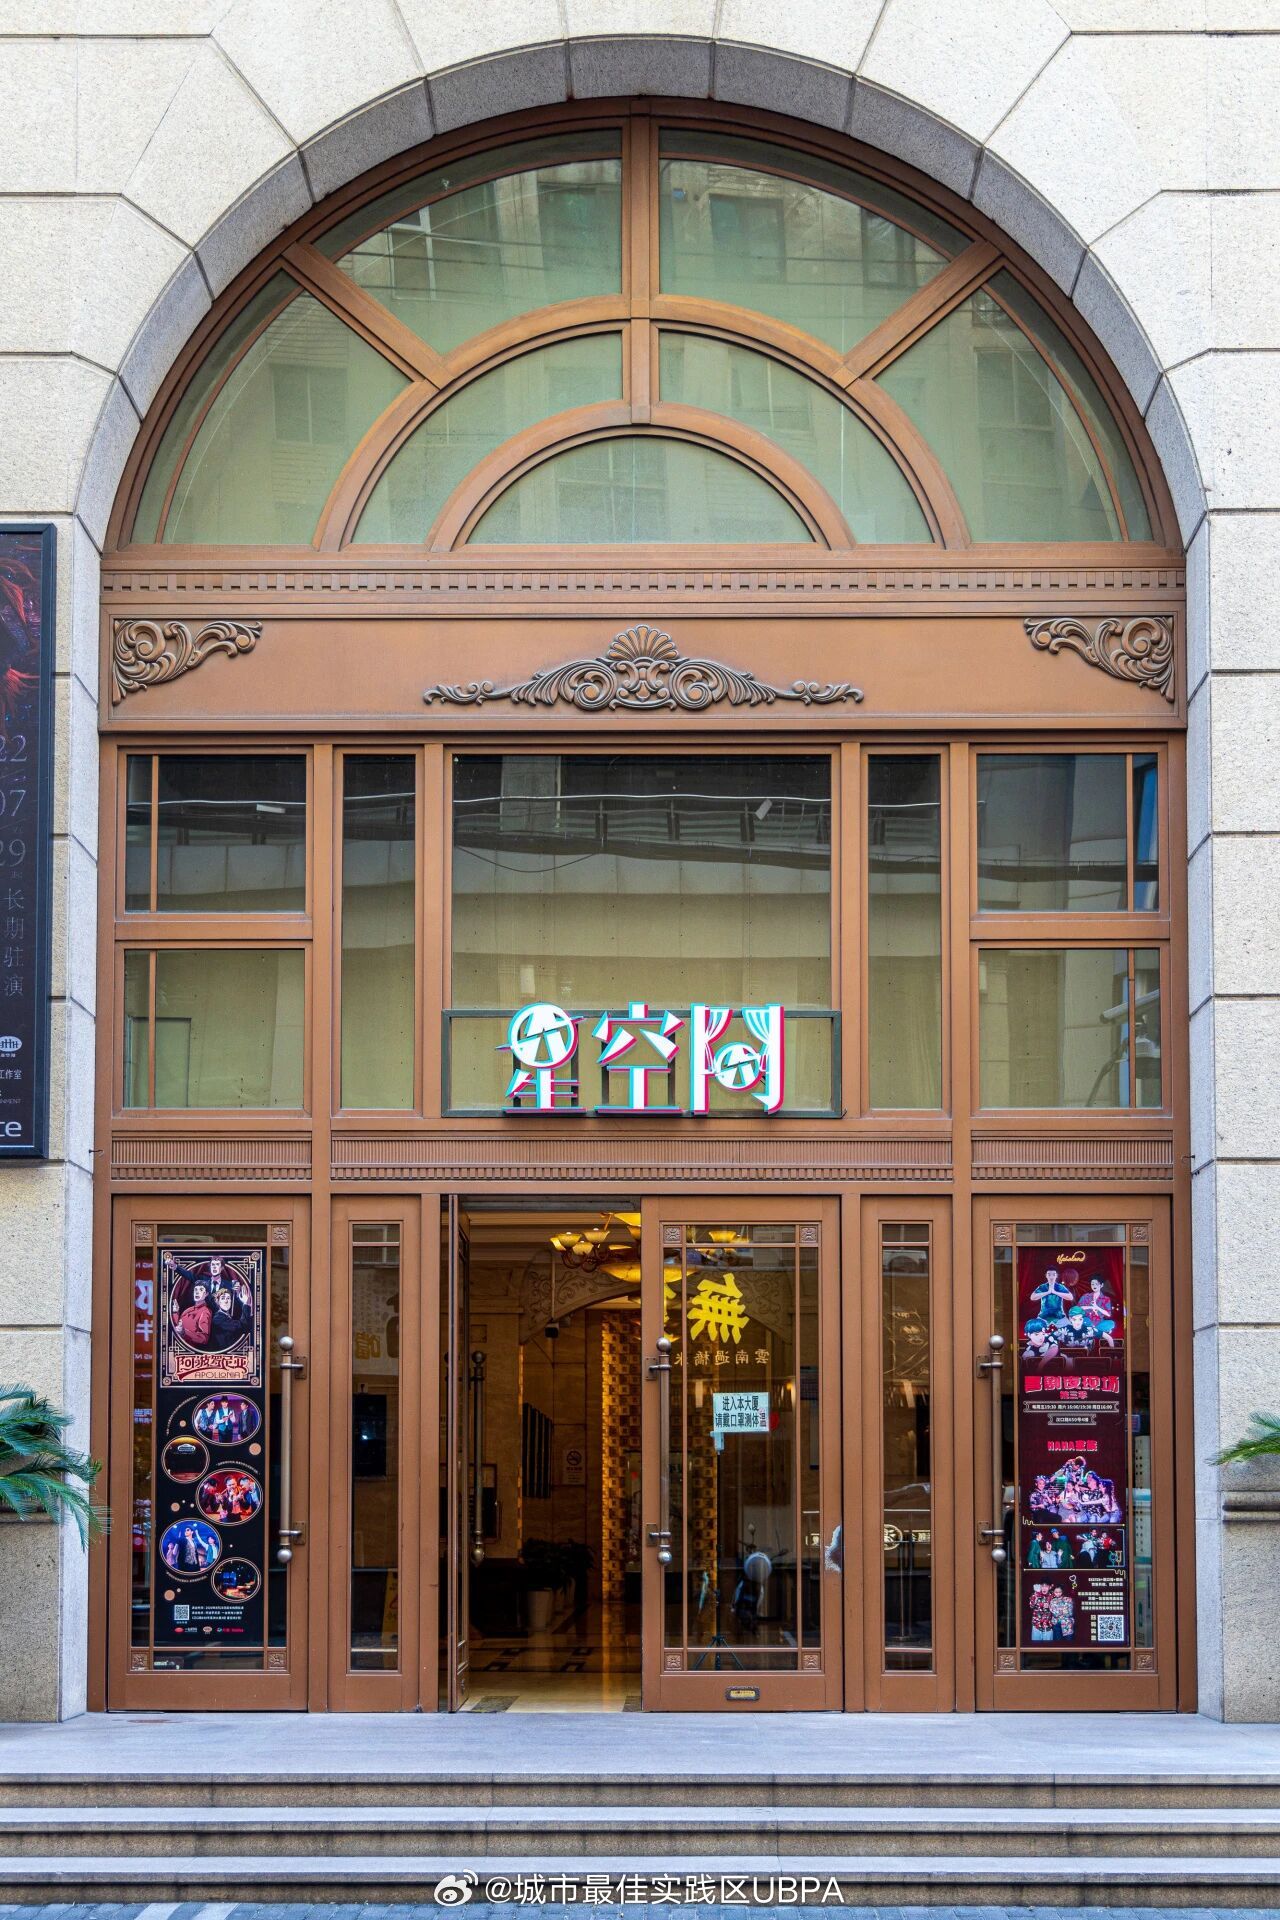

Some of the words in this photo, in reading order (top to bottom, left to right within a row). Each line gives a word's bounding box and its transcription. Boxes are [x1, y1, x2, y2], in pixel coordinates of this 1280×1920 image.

[3, 887, 24, 997] 长期驻演
[175, 1354, 248, 1374] 阿波罗尼亚
[722, 1395, 760, 1412] 进入本大厦
[715, 1412, 767, 1428] 请戴口罩测体温
